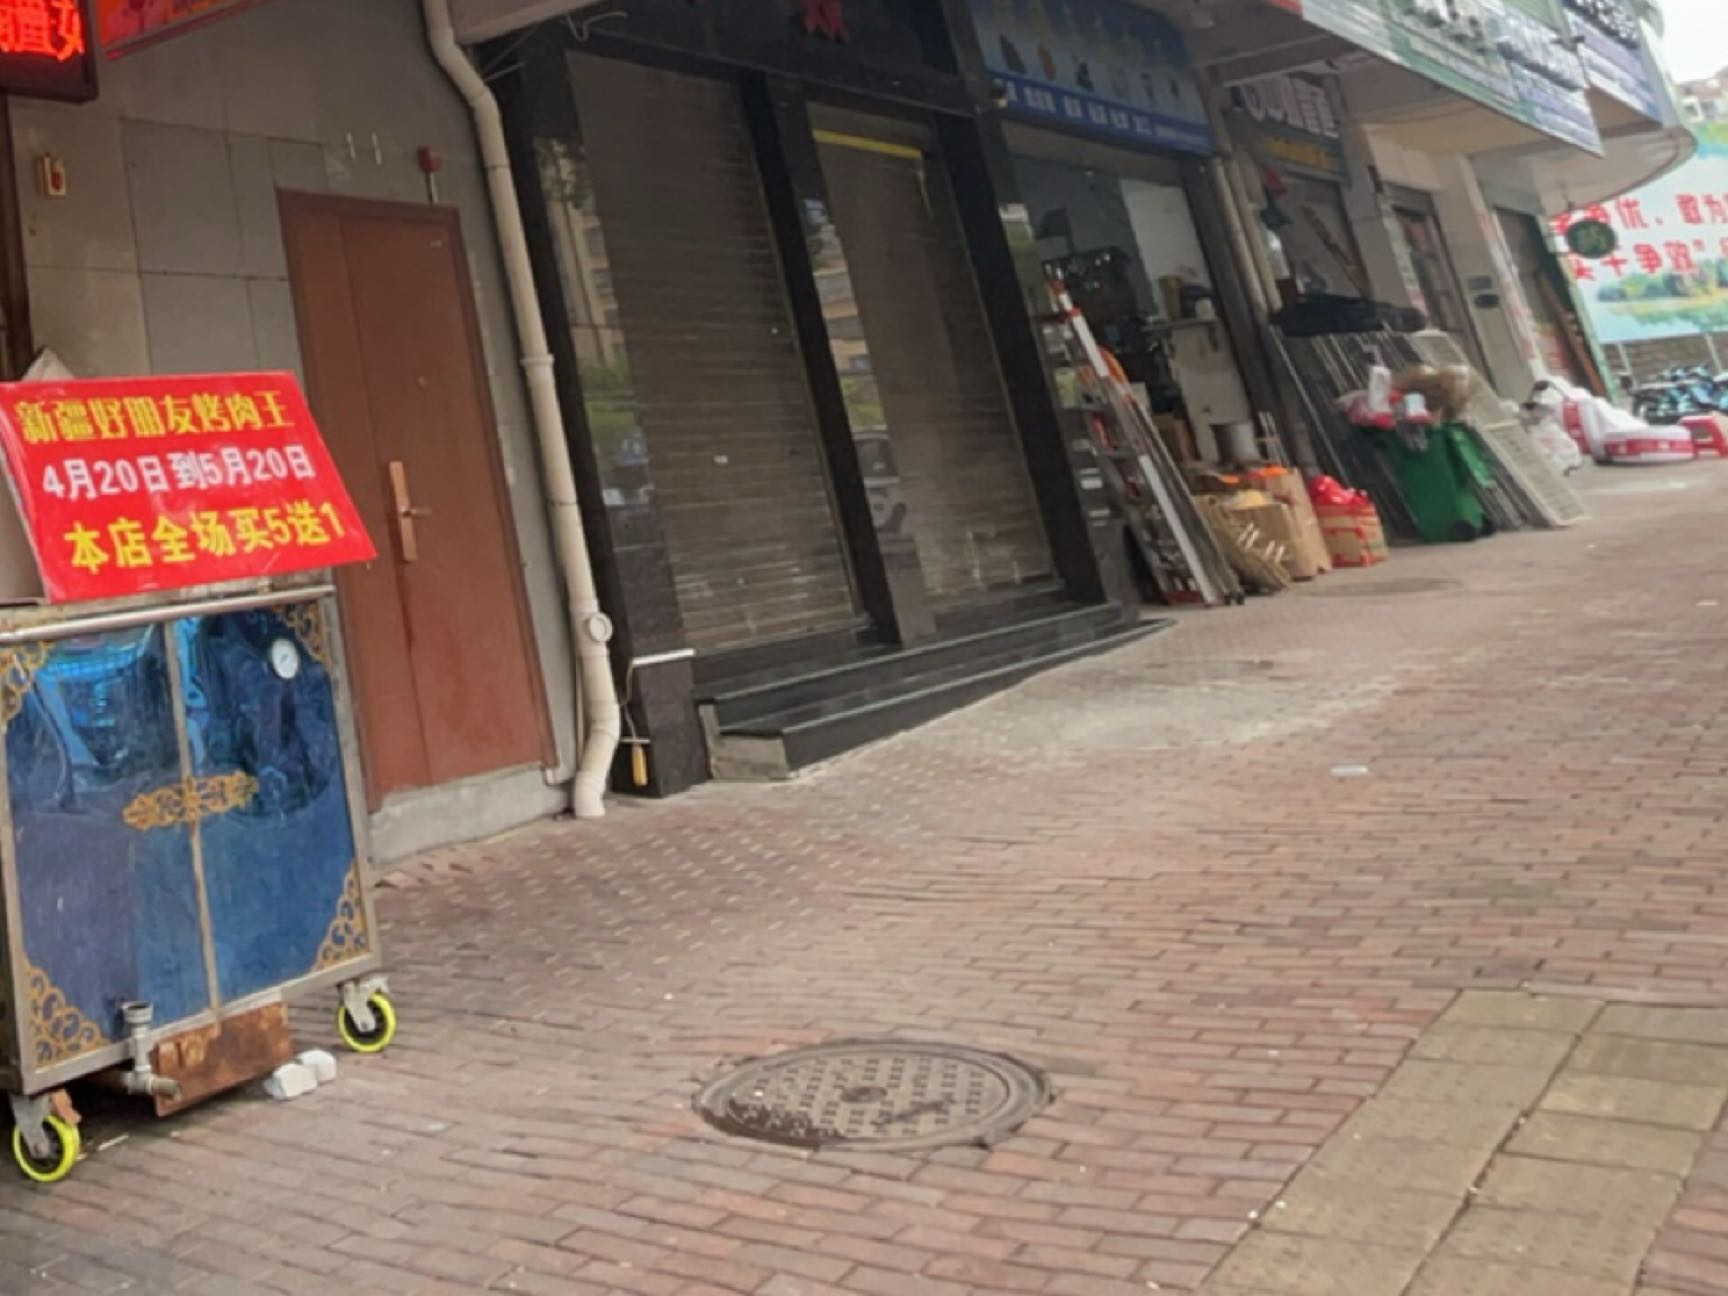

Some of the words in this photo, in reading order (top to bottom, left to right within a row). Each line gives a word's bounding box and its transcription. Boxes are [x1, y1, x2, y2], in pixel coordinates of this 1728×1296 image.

[17, 390, 295, 444] 新疆好朋友烤肉王
[64, 500, 346, 575] 本店全场买5送1
